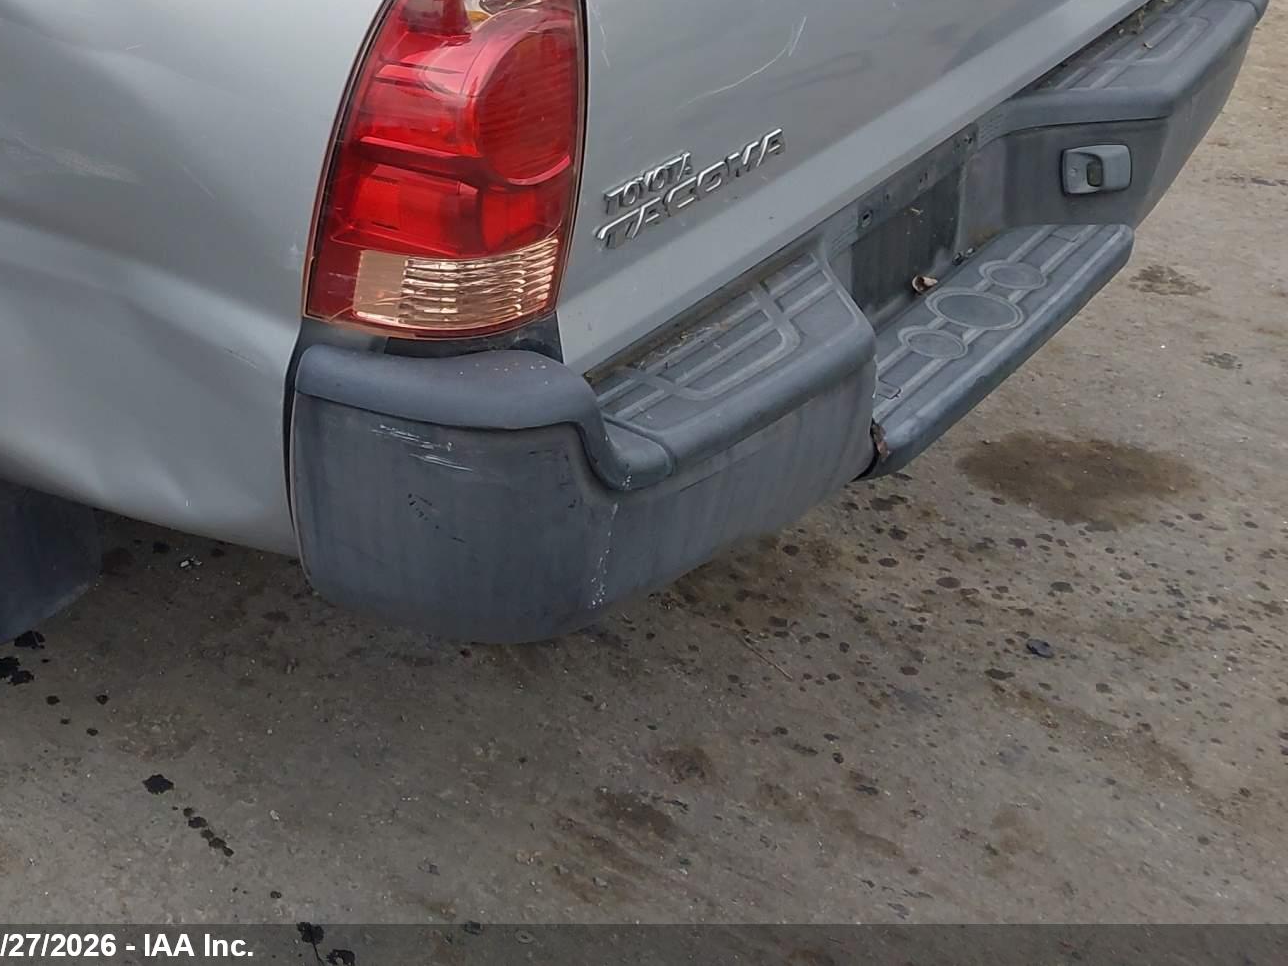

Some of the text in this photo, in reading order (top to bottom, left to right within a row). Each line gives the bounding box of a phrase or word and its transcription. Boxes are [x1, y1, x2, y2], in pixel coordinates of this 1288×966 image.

[595, 127, 786, 249] TACOMA
[604, 151, 693, 215] TOYOTA
[272, 273, 291, 282] STOP
